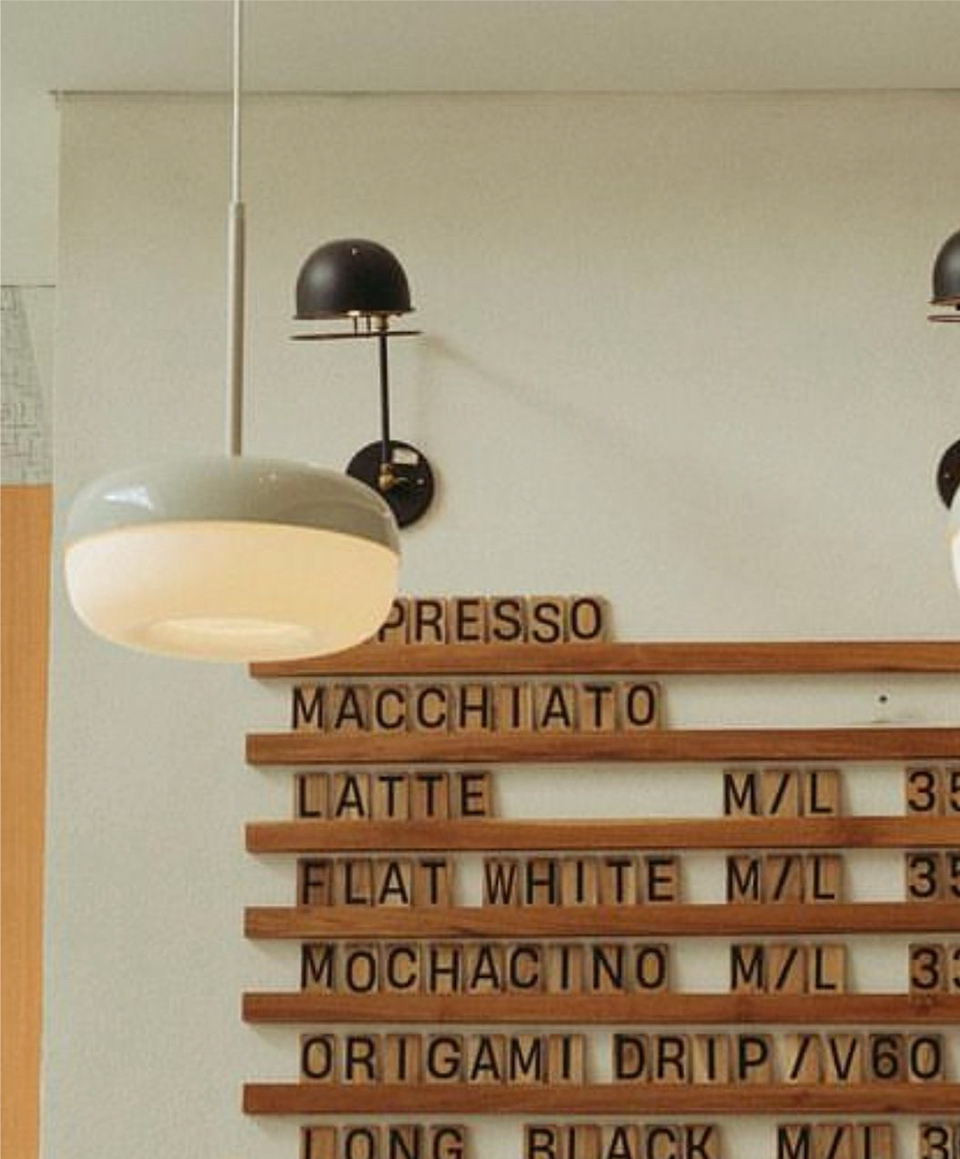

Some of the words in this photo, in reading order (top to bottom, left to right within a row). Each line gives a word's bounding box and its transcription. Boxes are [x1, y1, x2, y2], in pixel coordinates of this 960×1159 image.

[378, 598, 602, 643] PRESSO
[292, 686, 657, 730] MACCHIATO
[298, 774, 486, 818] LATTE
[724, 772, 832, 815] M/L
[301, 861, 447, 905] FLAT
[484, 859, 675, 905] WHITE
[727, 855, 835, 901] M/L
[301, 945, 668, 992] MOCHACINO
[730, 945, 838, 991] M/L
[301, 1037, 573, 1080] ORIGAMI
